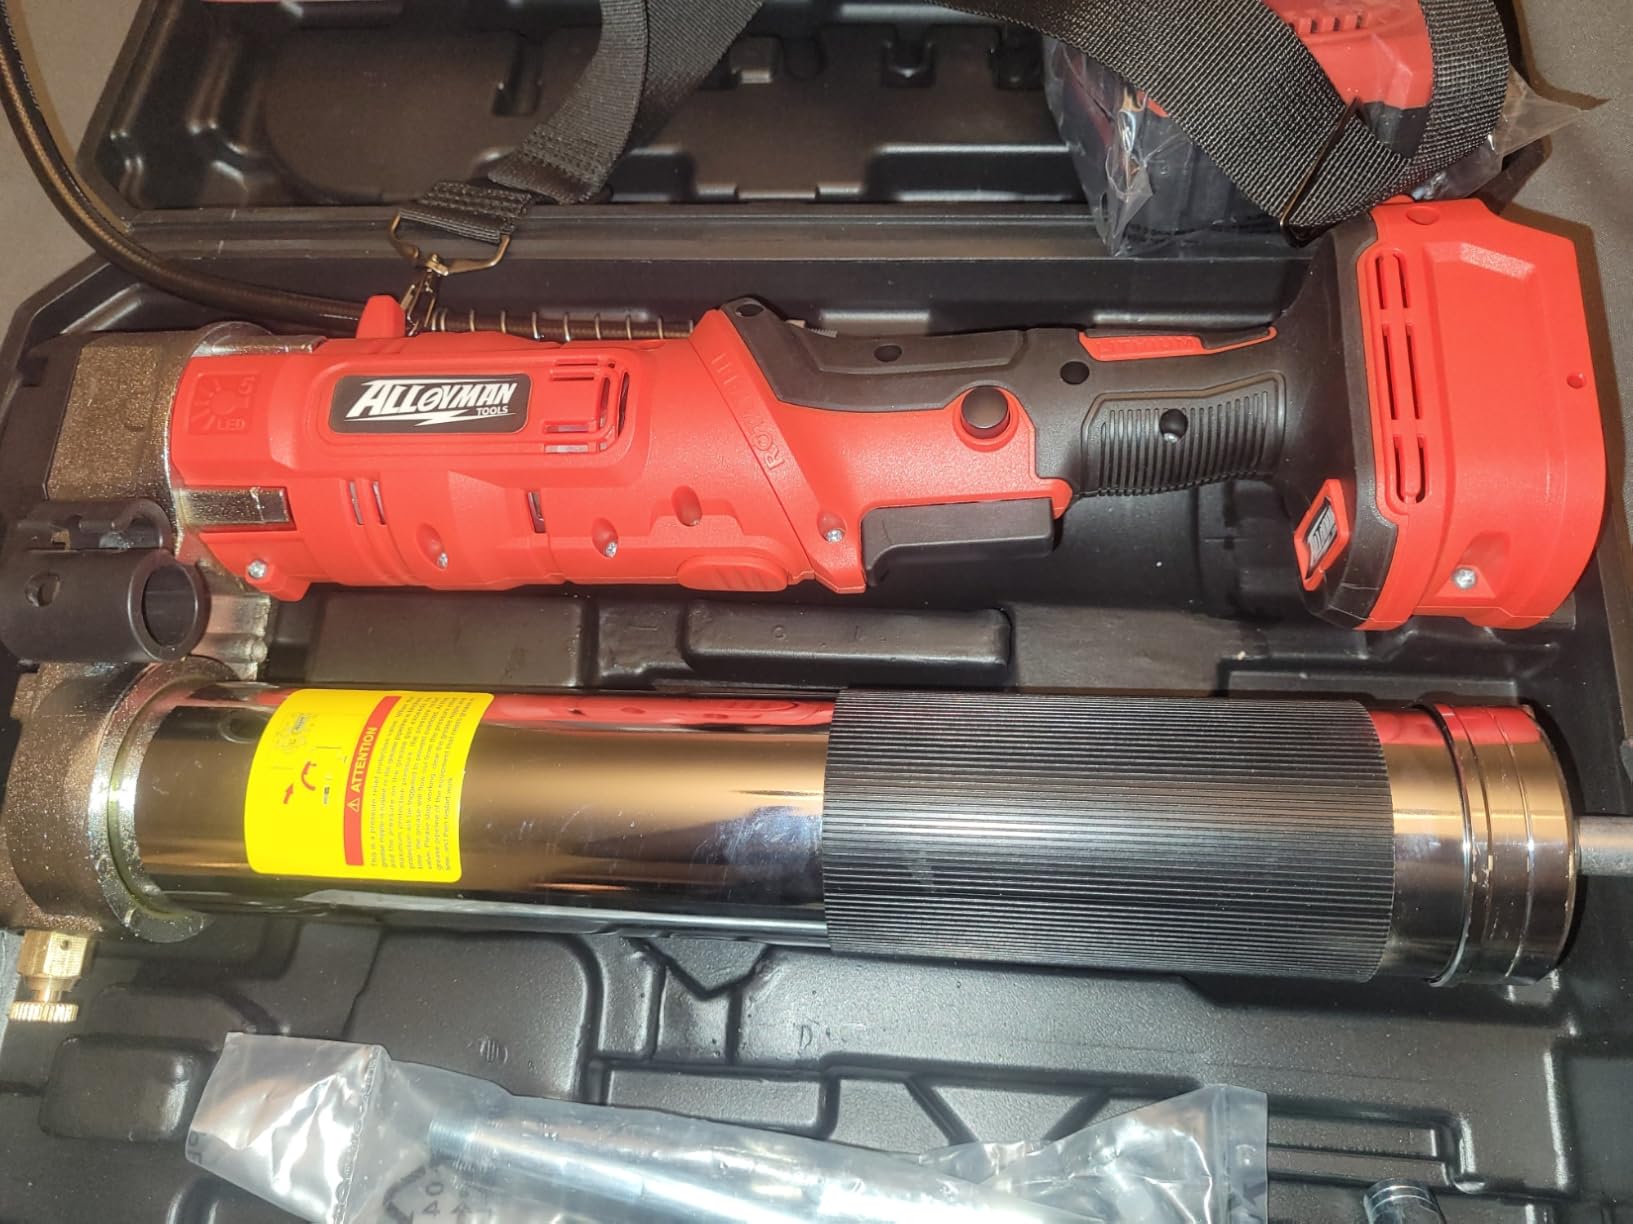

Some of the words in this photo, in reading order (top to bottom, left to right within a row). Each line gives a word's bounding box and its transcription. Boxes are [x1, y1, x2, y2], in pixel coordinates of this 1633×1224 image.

[345, 382, 518, 418] ALLOYMAN
[476, 406, 509, 417] TOOLS
[351, 726, 379, 793] ATTENTION
